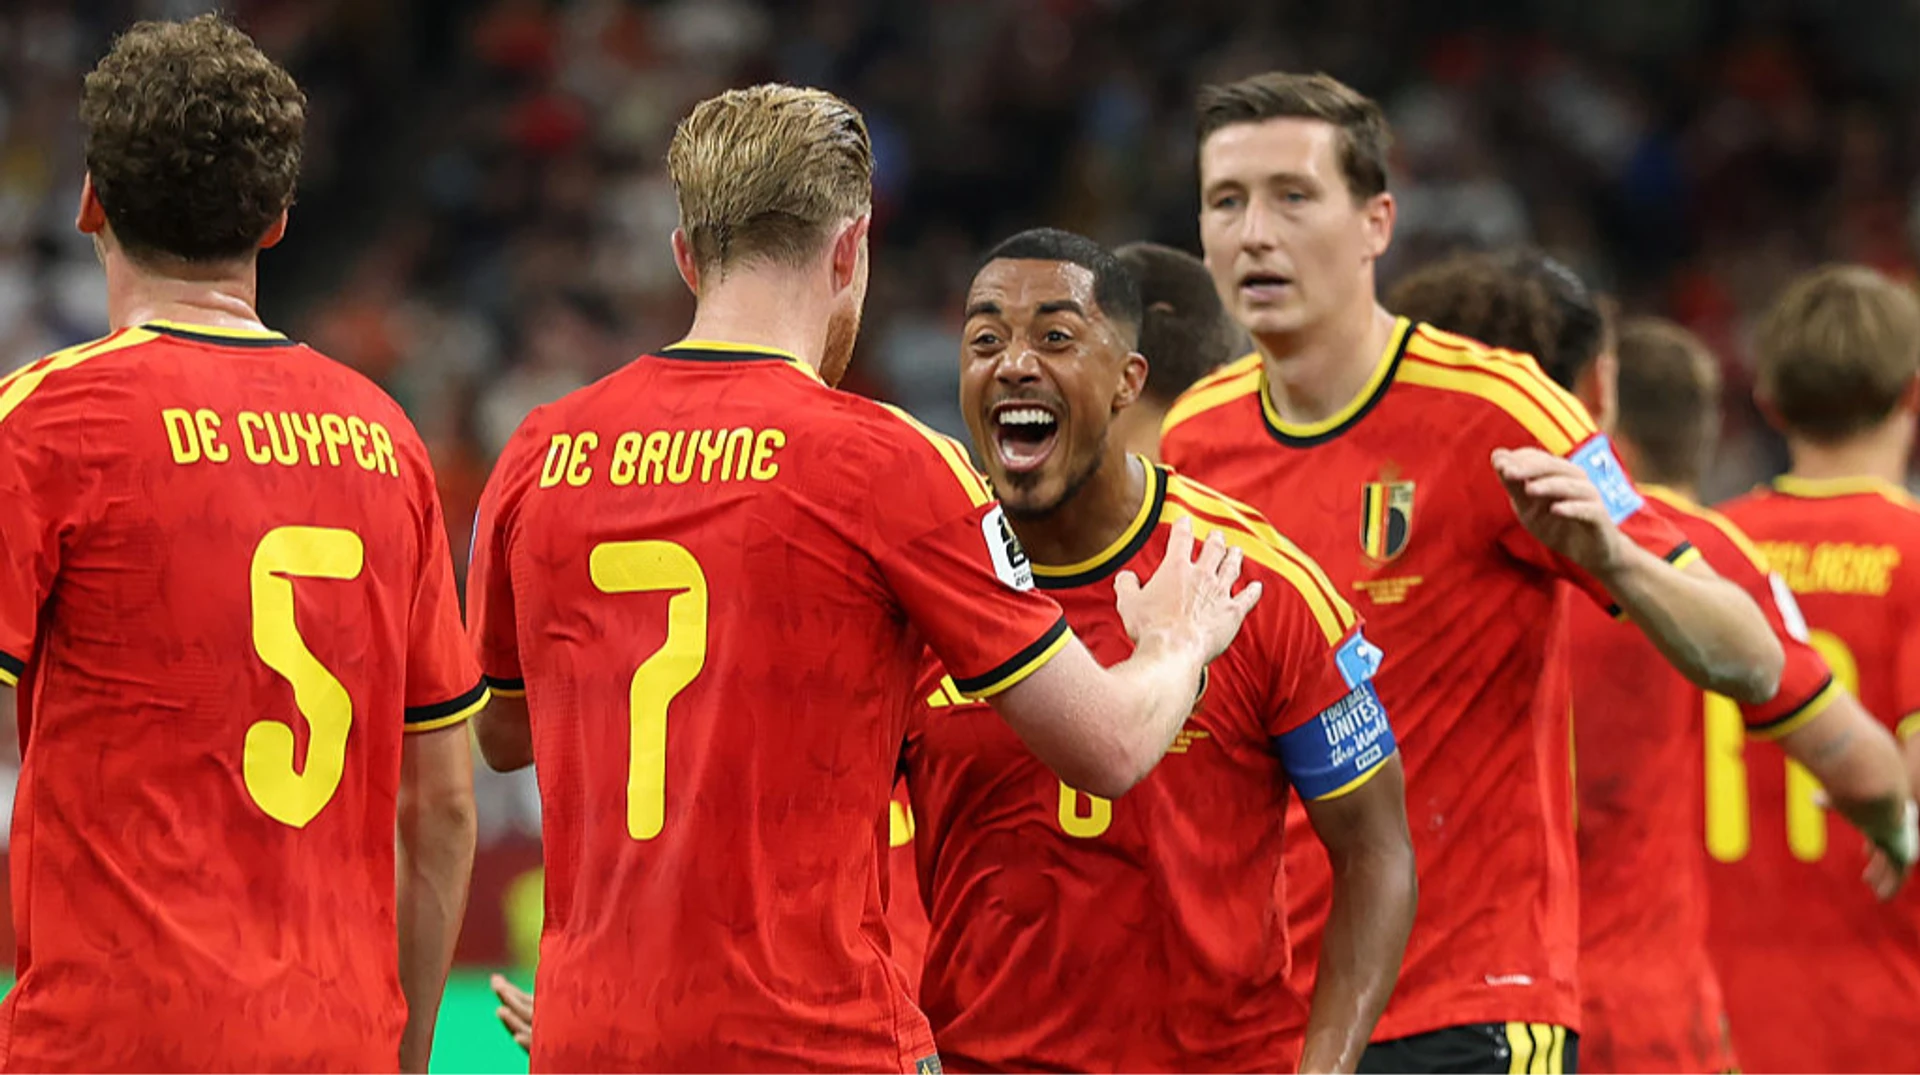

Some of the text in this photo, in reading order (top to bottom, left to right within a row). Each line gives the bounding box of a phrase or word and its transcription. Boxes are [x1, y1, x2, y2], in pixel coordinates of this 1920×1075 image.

[162, 408, 400, 477] DE CUYPER
[539, 427, 785, 487] DE BRUYNE
[243, 525, 364, 829] 5
[589, 539, 708, 840] 7
[1325, 696, 1379, 747] UNITES
[1353, 713, 1388, 751] World
